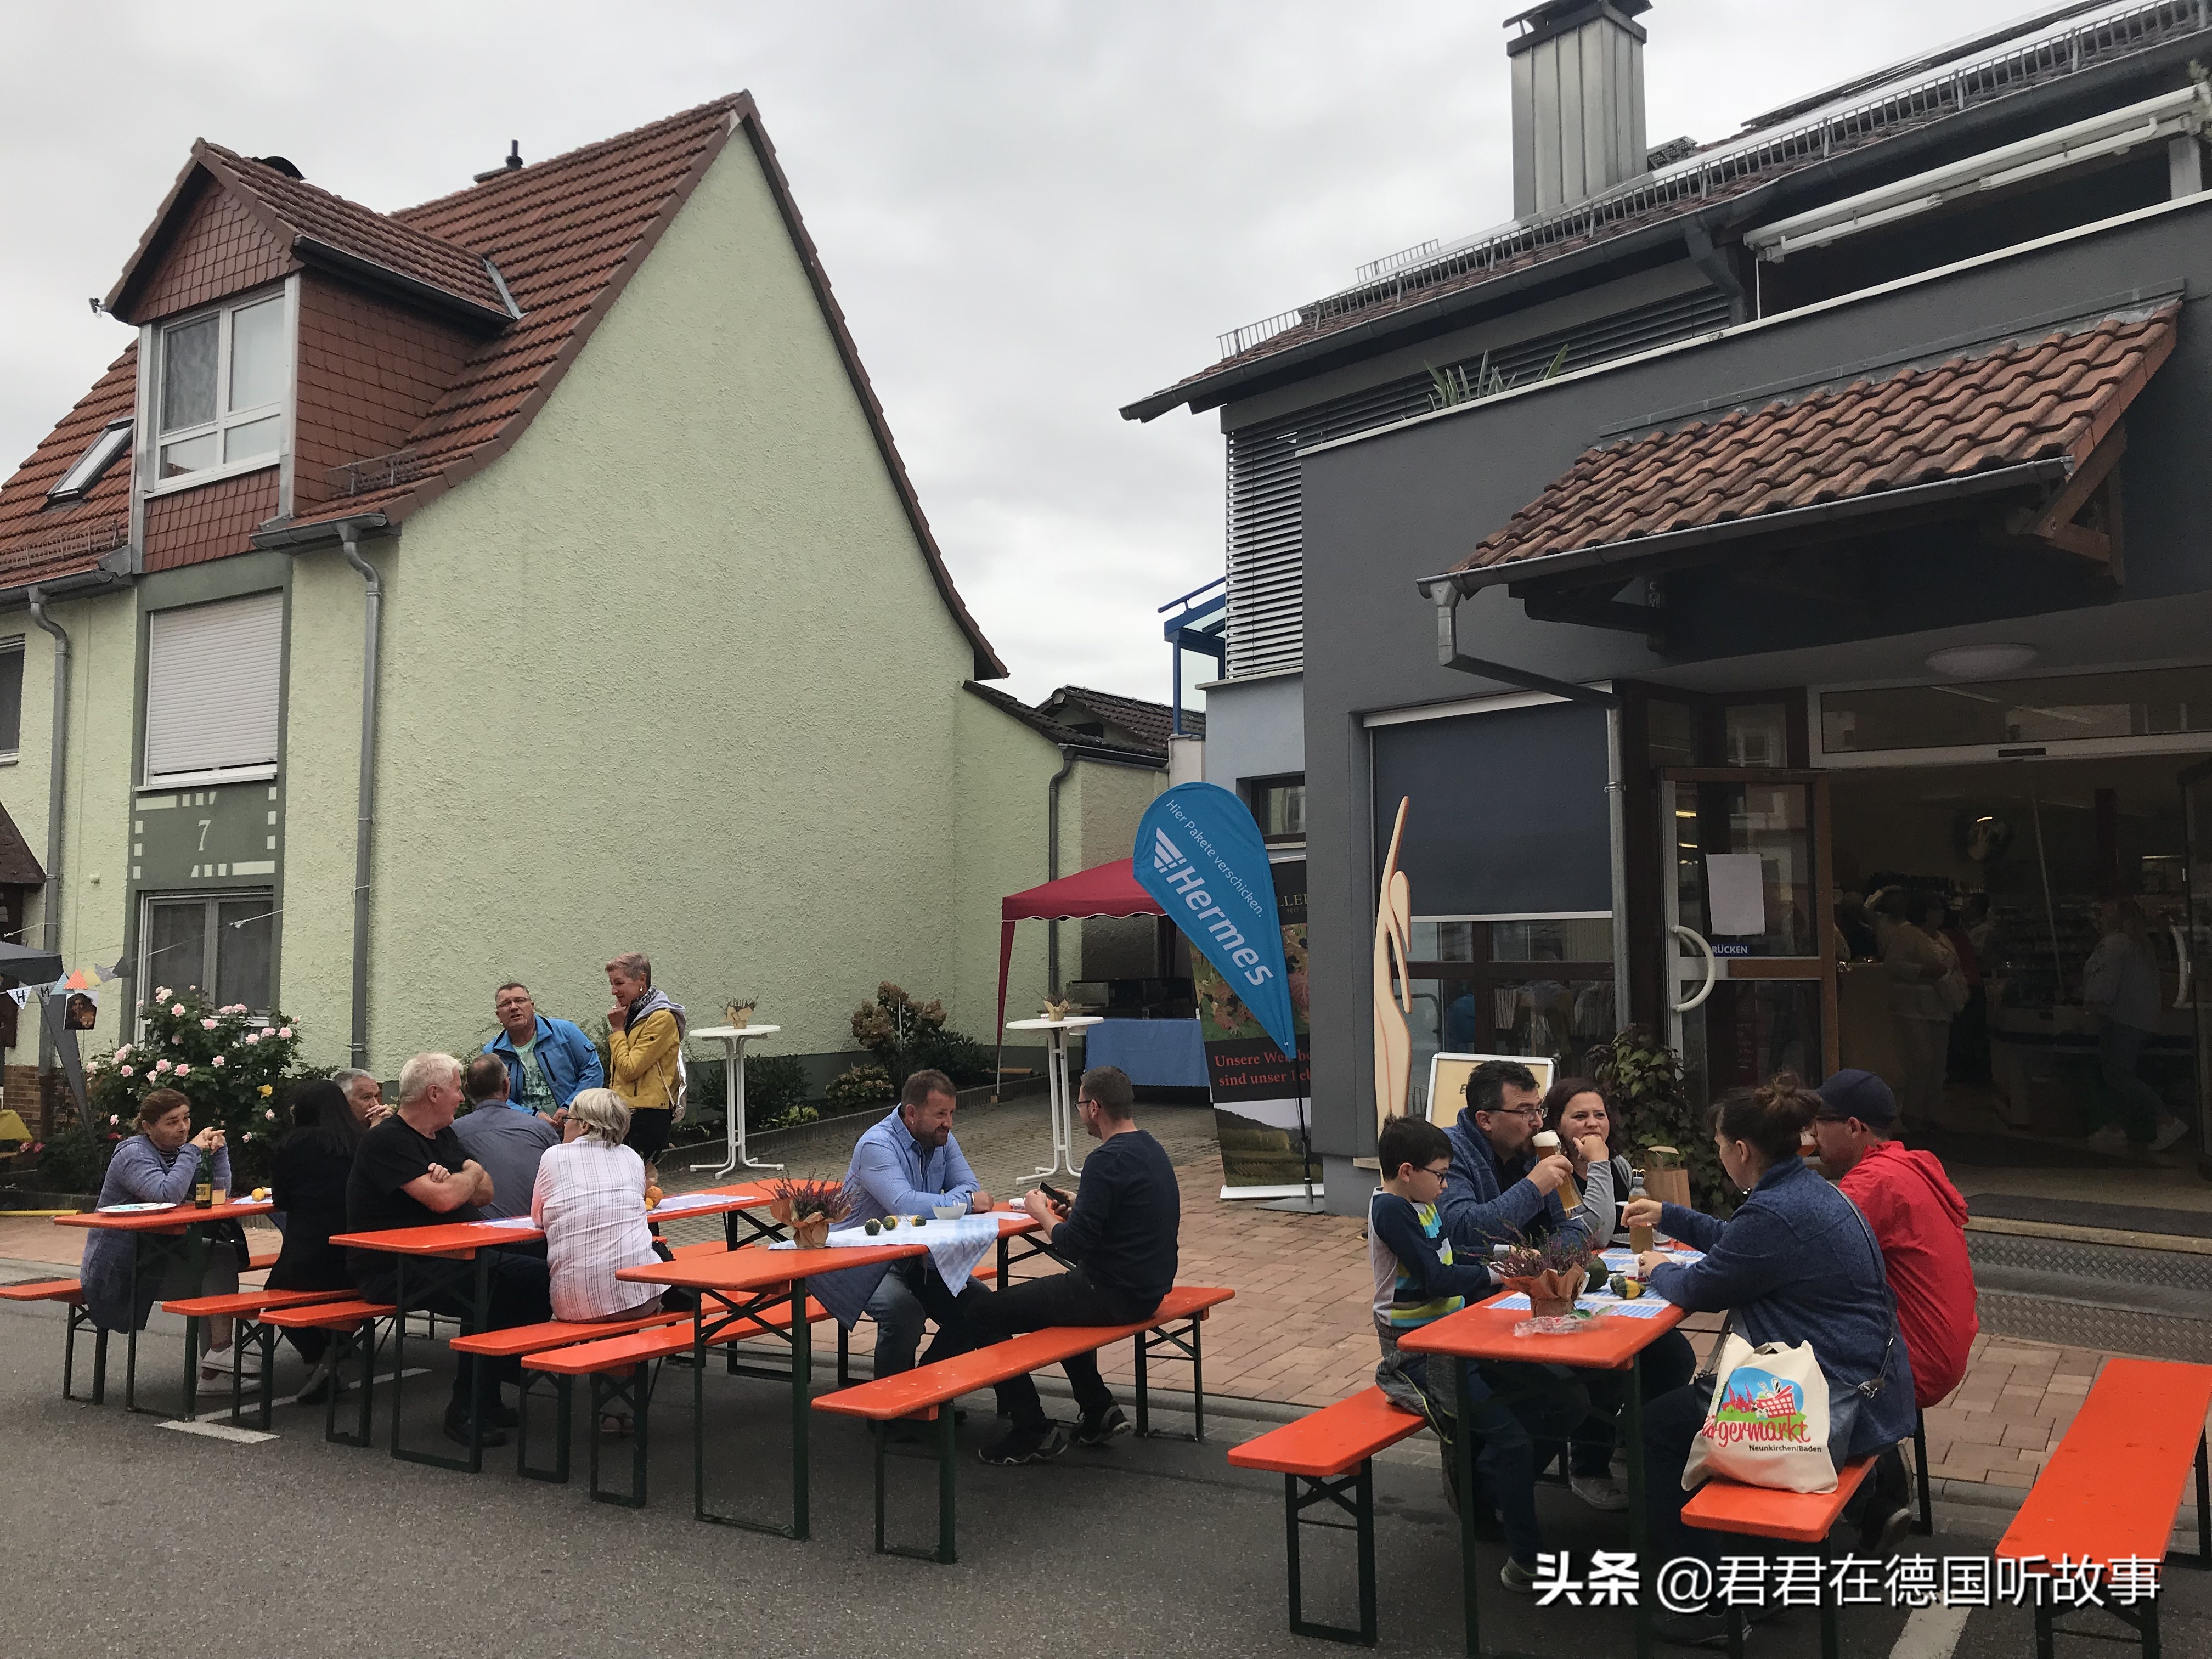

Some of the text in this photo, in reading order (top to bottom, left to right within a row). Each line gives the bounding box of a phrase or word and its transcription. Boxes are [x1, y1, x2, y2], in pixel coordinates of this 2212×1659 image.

[198, 820, 211, 851] 7
[1166, 799, 1262, 918] Hier Pakete verschicken.
[1166, 866, 1273, 986] Hermes
[1712, 944, 1748, 953] RÜCKEN
[1214, 1054, 1260, 1067] Unsere
[1219, 1072, 1247, 1086] sind
[1250, 1073, 1286, 1084] unser
[1748, 1444, 1822, 1453] Neunkirchen/Baden
